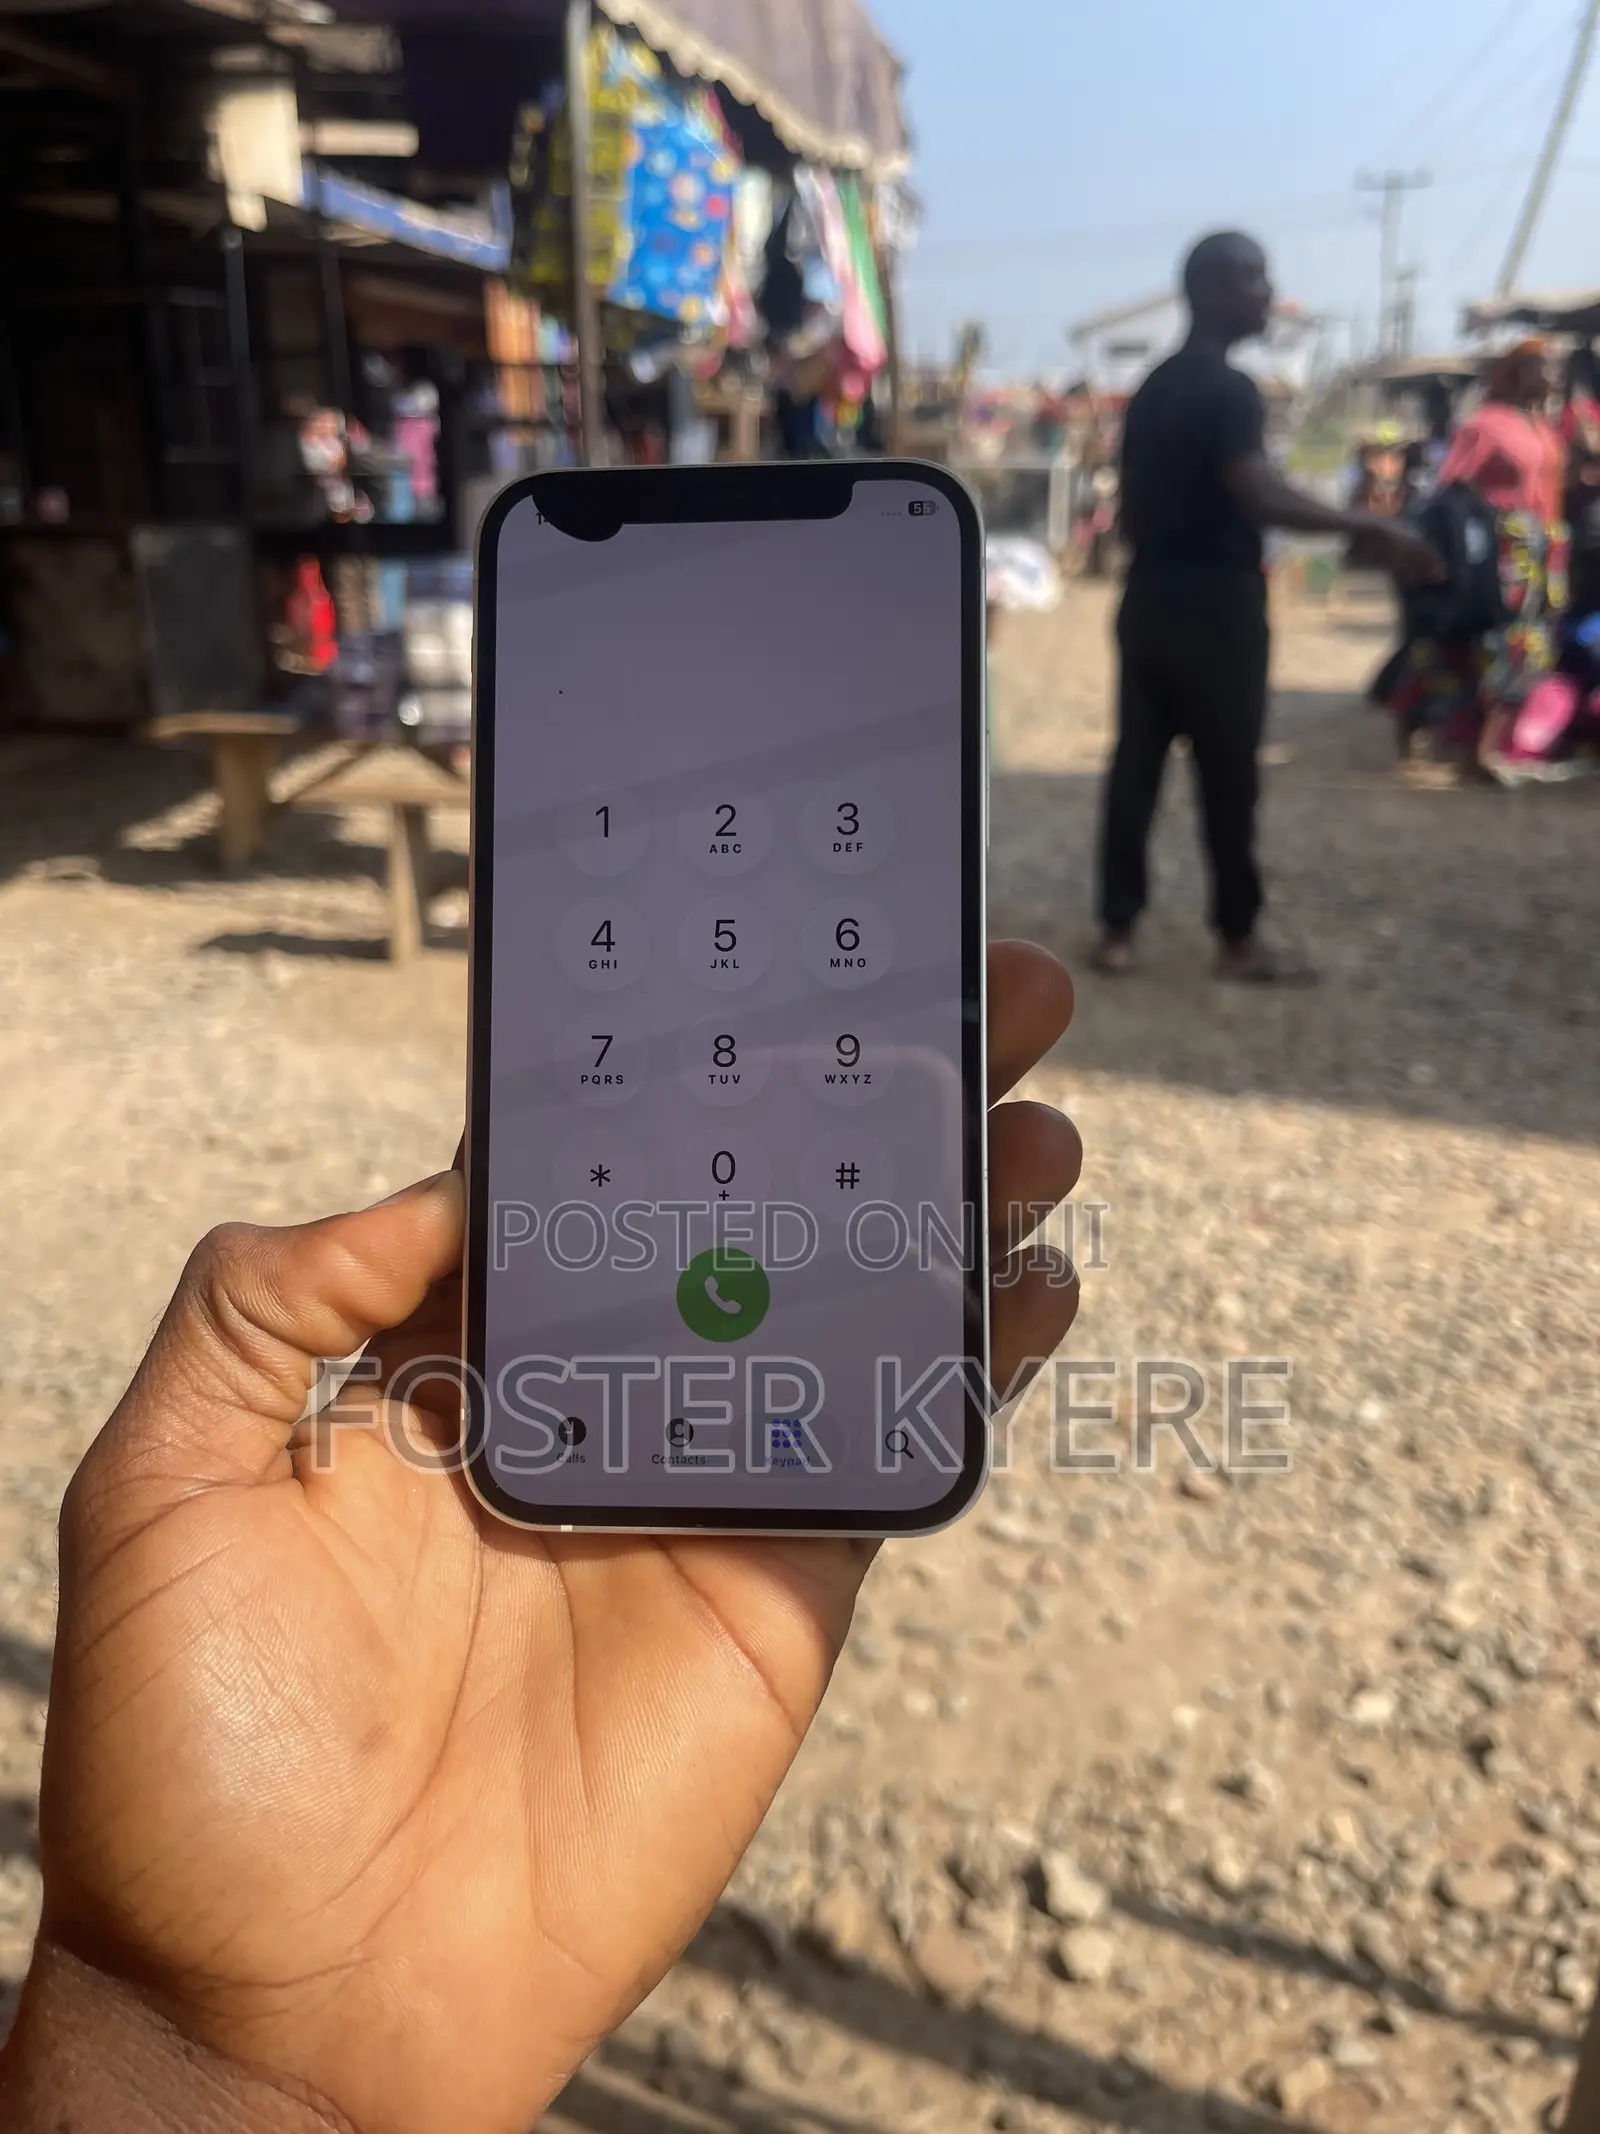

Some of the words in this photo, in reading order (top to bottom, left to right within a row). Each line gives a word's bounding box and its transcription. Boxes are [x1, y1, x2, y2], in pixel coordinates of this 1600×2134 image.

[913, 503, 931, 514] 55
[595, 805, 610, 838] 1
[715, 804, 737, 837] 2
[836, 802, 860, 836] 3
[709, 844, 742, 854] ABC
[833, 842, 864, 853] DEF
[590, 920, 616, 952] 4
[713, 919, 737, 952] 5
[835, 918, 860, 951] 6
[588, 959, 618, 970] GHI
[710, 958, 740, 969] JKL
[830, 958, 867, 969] MNO
[591, 1035, 614, 1068] 7
[712, 1034, 737, 1068] 8
[835, 1033, 860, 1068] 9
[580, 1074, 624, 1086] PQRS
[708, 1074, 741, 1085] TUV
[824, 1074, 872, 1085] WXYZ
[711, 1151, 736, 1184] 0
[835, 1162, 860, 1190] #
[556, 1453, 586, 1464] Calls
[651, 1453, 706, 1466] Contacts
